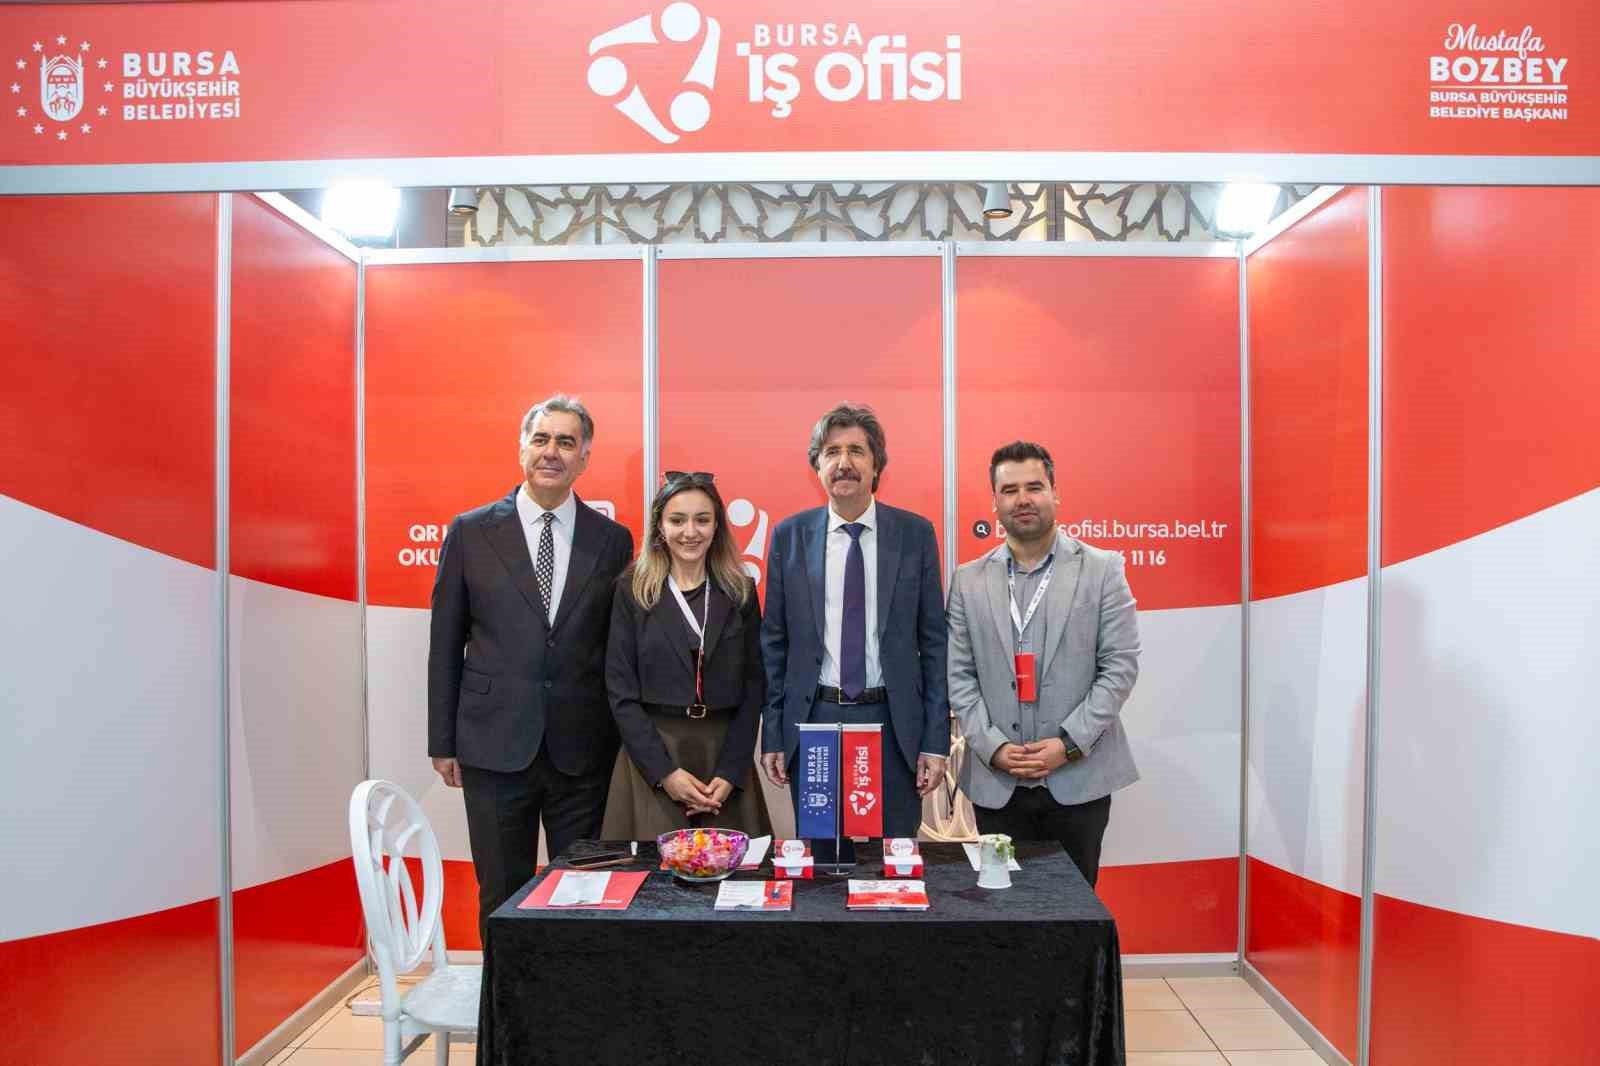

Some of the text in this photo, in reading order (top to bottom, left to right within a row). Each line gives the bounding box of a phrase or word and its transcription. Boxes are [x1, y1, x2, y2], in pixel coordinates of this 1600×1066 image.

[755, 23, 863, 46] BURSA
[1444, 23, 1545, 60] Mustafa
[123, 51, 241, 77] BURSA
[1430, 56, 1568, 83] BOZBEY
[123, 77, 240, 99] BÜYÜKŞEHİR
[736, 35, 962, 119] iş ofisi
[1430, 90, 1567, 105] BURSA BÜYÜKŞEHİR
[123, 99, 241, 121] BELEDİYESİ
[1430, 104, 1568, 122] BELEDİYE BAŞKANI
[409, 524, 439, 542] QR
[995, 519, 1228, 538] bsofisi.bursa.bel.tr
[807, 746, 816, 783] BURSA
